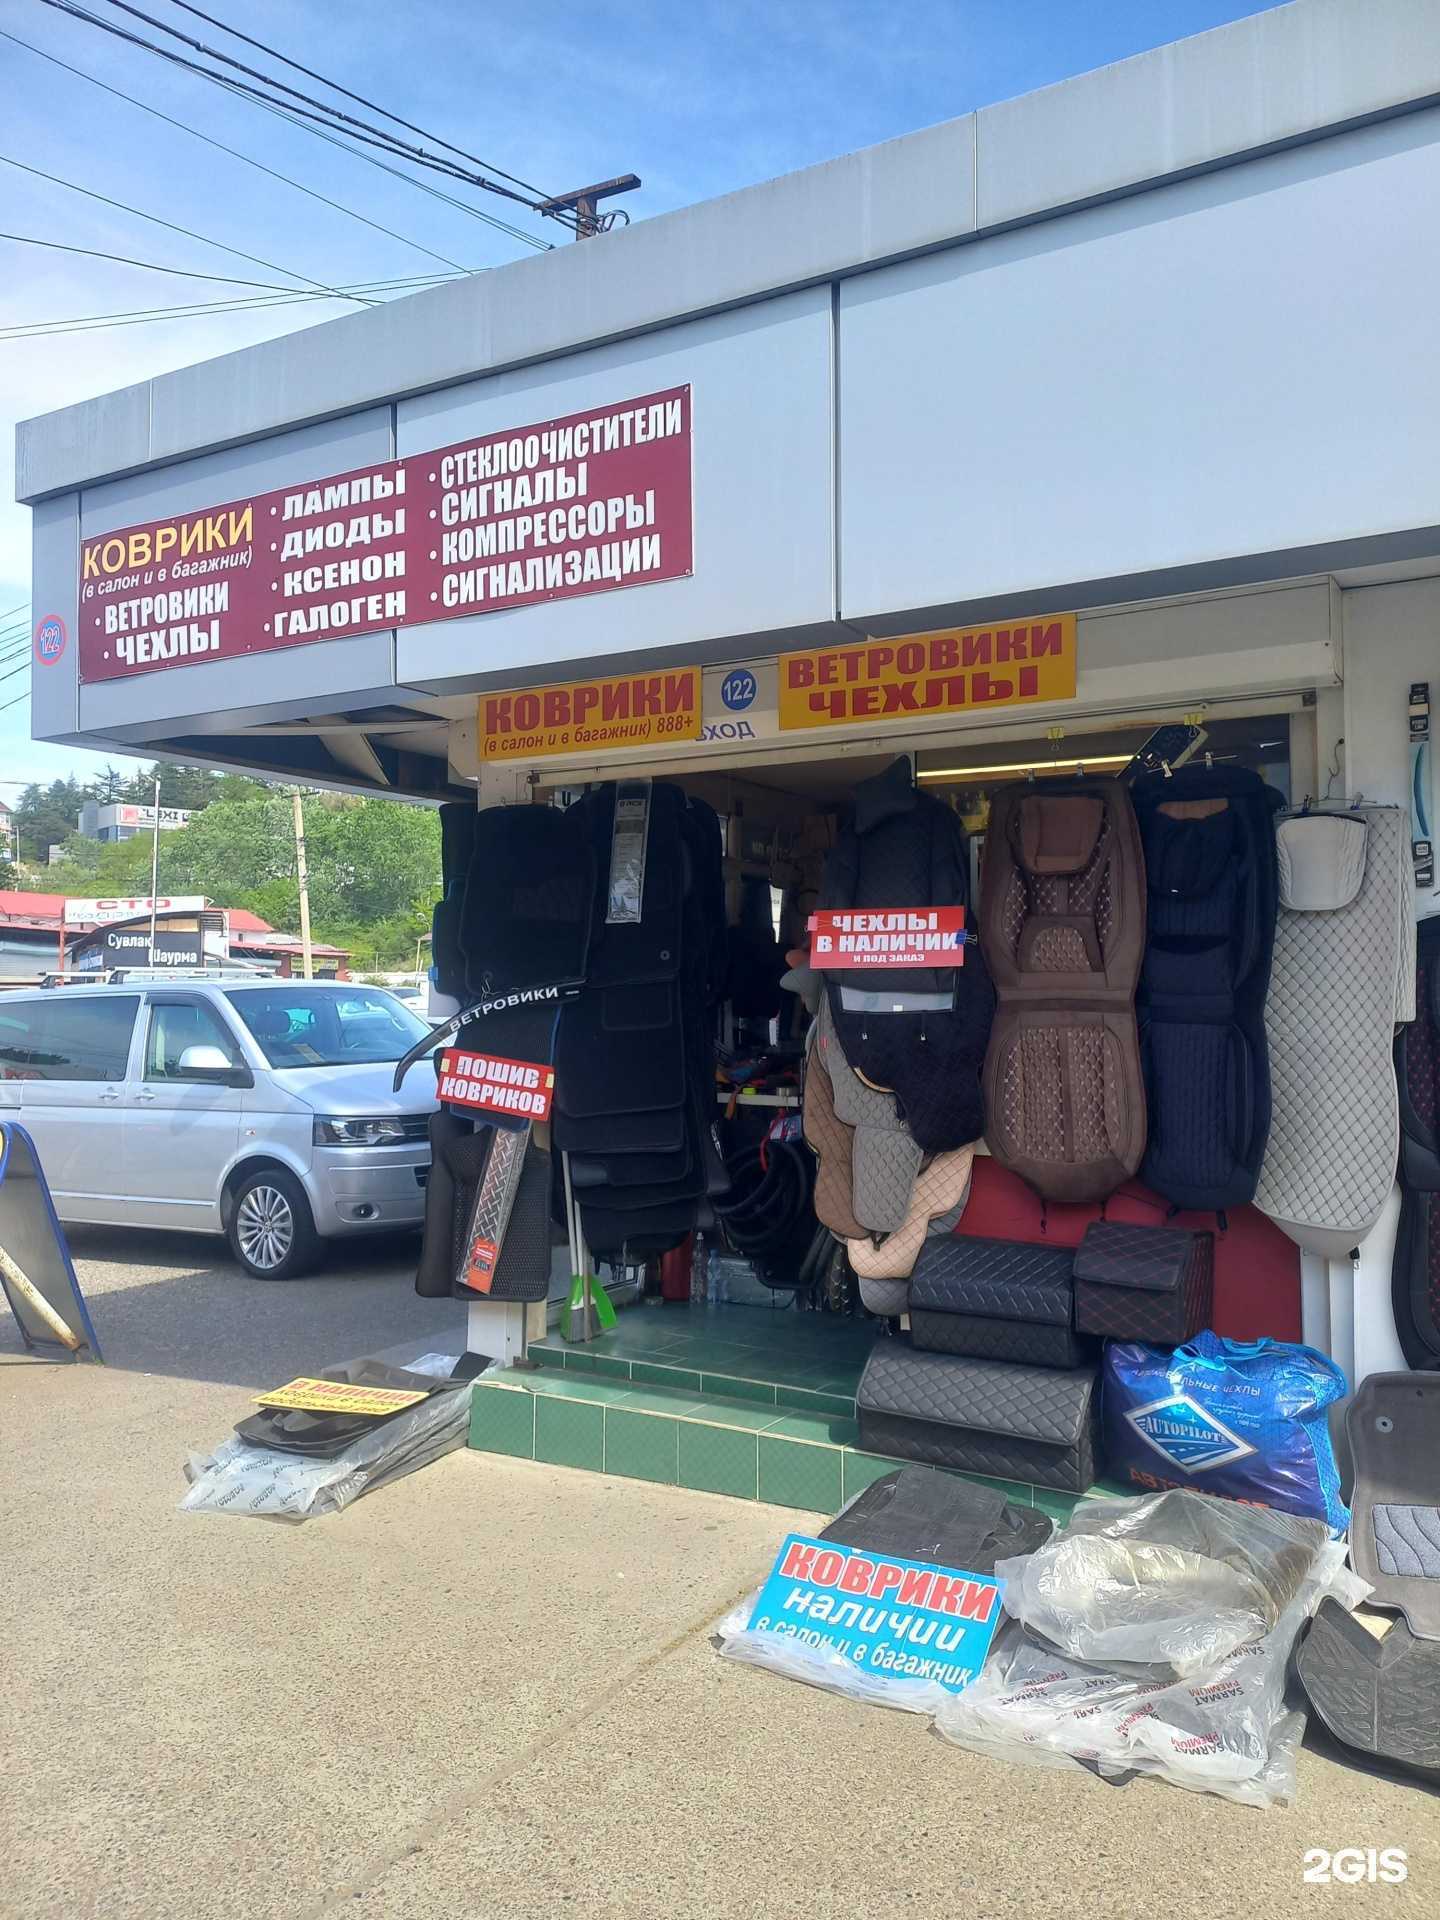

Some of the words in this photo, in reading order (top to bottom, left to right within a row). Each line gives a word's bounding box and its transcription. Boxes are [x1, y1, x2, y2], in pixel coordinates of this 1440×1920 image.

[441, 399, 682, 489] СТЕКЛООЧИСТИТЕЛИ
[282, 469, 405, 521] ЛАМПЫ
[442, 462, 588, 526] СИГНАЛЫ
[83, 506, 252, 579] КОВРИКИ
[280, 508, 405, 562] ДИОДЫ
[442, 489, 655, 565] КОМПРЕССОРЫ
[97, 573, 140, 595] салон
[144, 570, 153, 584] и
[158, 568, 167, 582] в
[172, 545, 252, 578] багажник)
[284, 551, 405, 597] КСЕНОН
[442, 534, 660, 607] СИГНАЛИЗАЦИИ
[105, 581, 229, 634] ВЕТРОВИКИ
[274, 590, 405, 638] ГАЛОГЕН
[116, 619, 220, 665] ЧЕХЛЫ
[788, 623, 1062, 689] ВЕТРОВИКИ
[485, 672, 694, 735] КОВРИКИ
[724, 678, 753, 702] 122
[809, 665, 1038, 719] ЧЕХЛЫ
[501, 736, 543, 751] салон
[548, 734, 555, 746] и
[561, 732, 568, 744] в
[574, 718, 651, 743] багажник)
[657, 715, 693, 733] 888+
[96, 899, 171, 910] СТО
[832, 912, 938, 932] ЧЕХЛЫ
[148, 949, 197, 965] Шаурма
[816, 936, 833, 952] В
[839, 932, 958, 952] НАЛИЧИИ
[863, 954, 887, 963] ПОД
[889, 954, 925, 962] ЗАКАЗ
[450, 986, 559, 1033] ВЕТРОВИКИ
[441, 1076, 546, 1115] КОВРИКОВ
[456, 1055, 540, 1089] ПОШИВ
[1145, 1416, 1221, 1443] AUTOPILOT
[779, 1542, 999, 1623] КОВРИКИ
[783, 1588, 967, 1652] наличии
[853, 1643, 864, 1661] в
[870, 1638, 973, 1687] багажник
[1188, 1679, 1240, 1697] PREMIUM
[1194, 1687, 1245, 1706] SARMAT
[1170, 1731, 1220, 1750] PREMIUM
[1172, 1742, 1225, 1756] SARMAT
